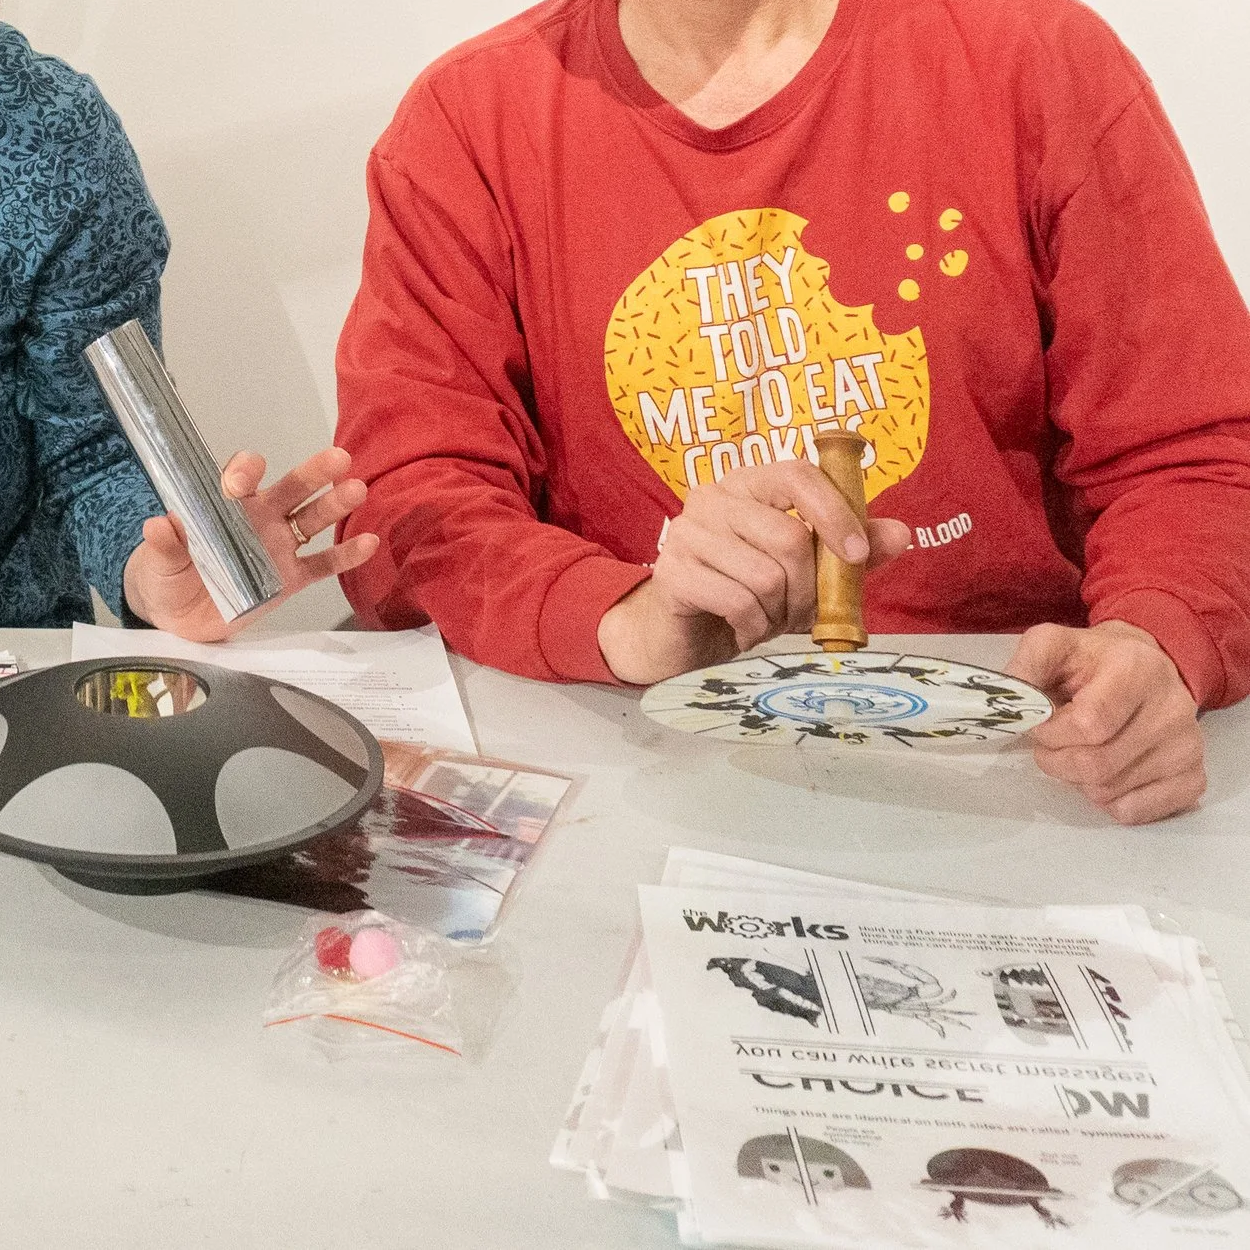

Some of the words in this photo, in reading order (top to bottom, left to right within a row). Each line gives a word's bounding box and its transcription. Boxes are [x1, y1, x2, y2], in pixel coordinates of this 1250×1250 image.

[686, 246, 797, 323] THEY
[699, 307, 807, 381] TOLD
[638, 386, 723, 447] ME
[733, 366, 793, 433] TO
[804, 353, 887, 421] EAT
[684, 414, 876, 490] COOKIS
[916, 513, 972, 548] BLOOD
